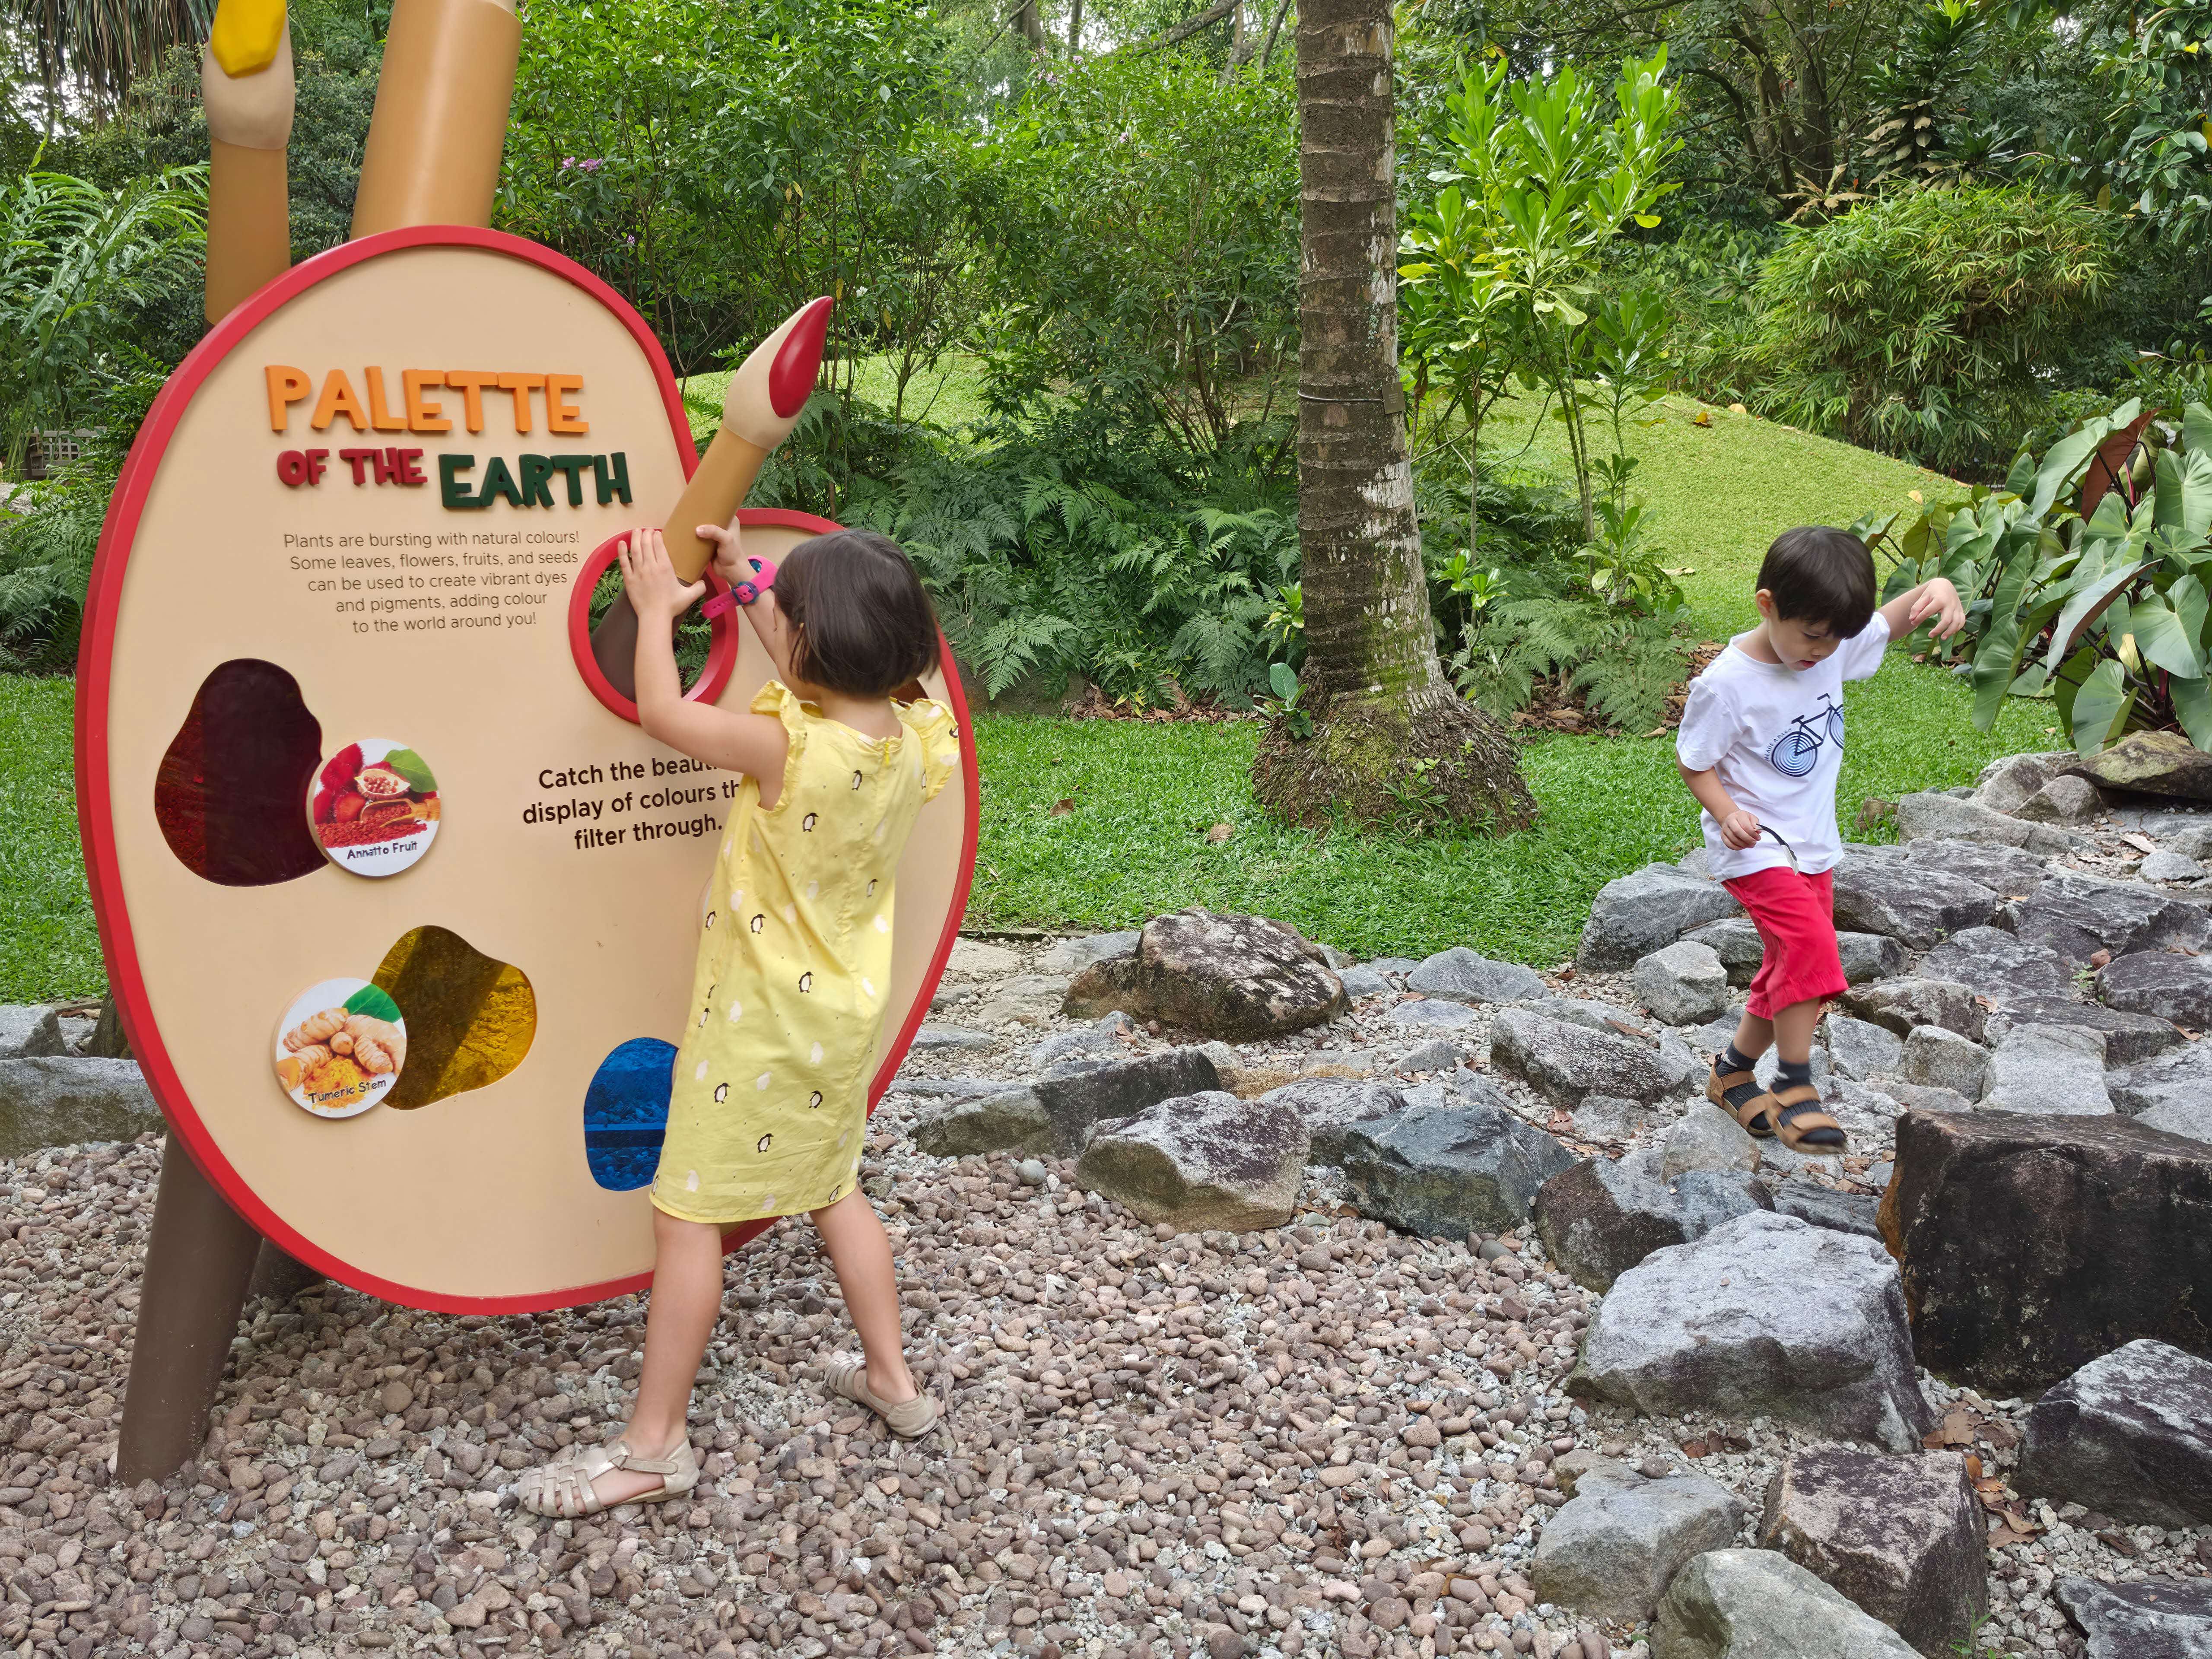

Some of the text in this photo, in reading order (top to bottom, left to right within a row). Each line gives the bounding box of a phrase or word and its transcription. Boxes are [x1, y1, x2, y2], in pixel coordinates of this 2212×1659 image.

[264, 365, 589, 432] PALETTE
[277, 447, 632, 509] OF THE EARTH
[283, 531, 580, 549] Plants are bursting with natural colours!
[290, 552, 578, 570] Some leaves, flowers, fruits, and seeds
[308, 572, 567, 592] can be used to create vibrant dyes
[336, 593, 547, 613] and pigments, adding colour
[353, 612, 537, 633] to the world around you!
[538, 757, 717, 788] Catch the beau
[523, 779, 741, 824] display of colours th
[575, 814, 723, 849] filter through.
[346, 841, 418, 859] Annatto Fruit
[308, 1080, 386, 1103] Tumeric Stem
